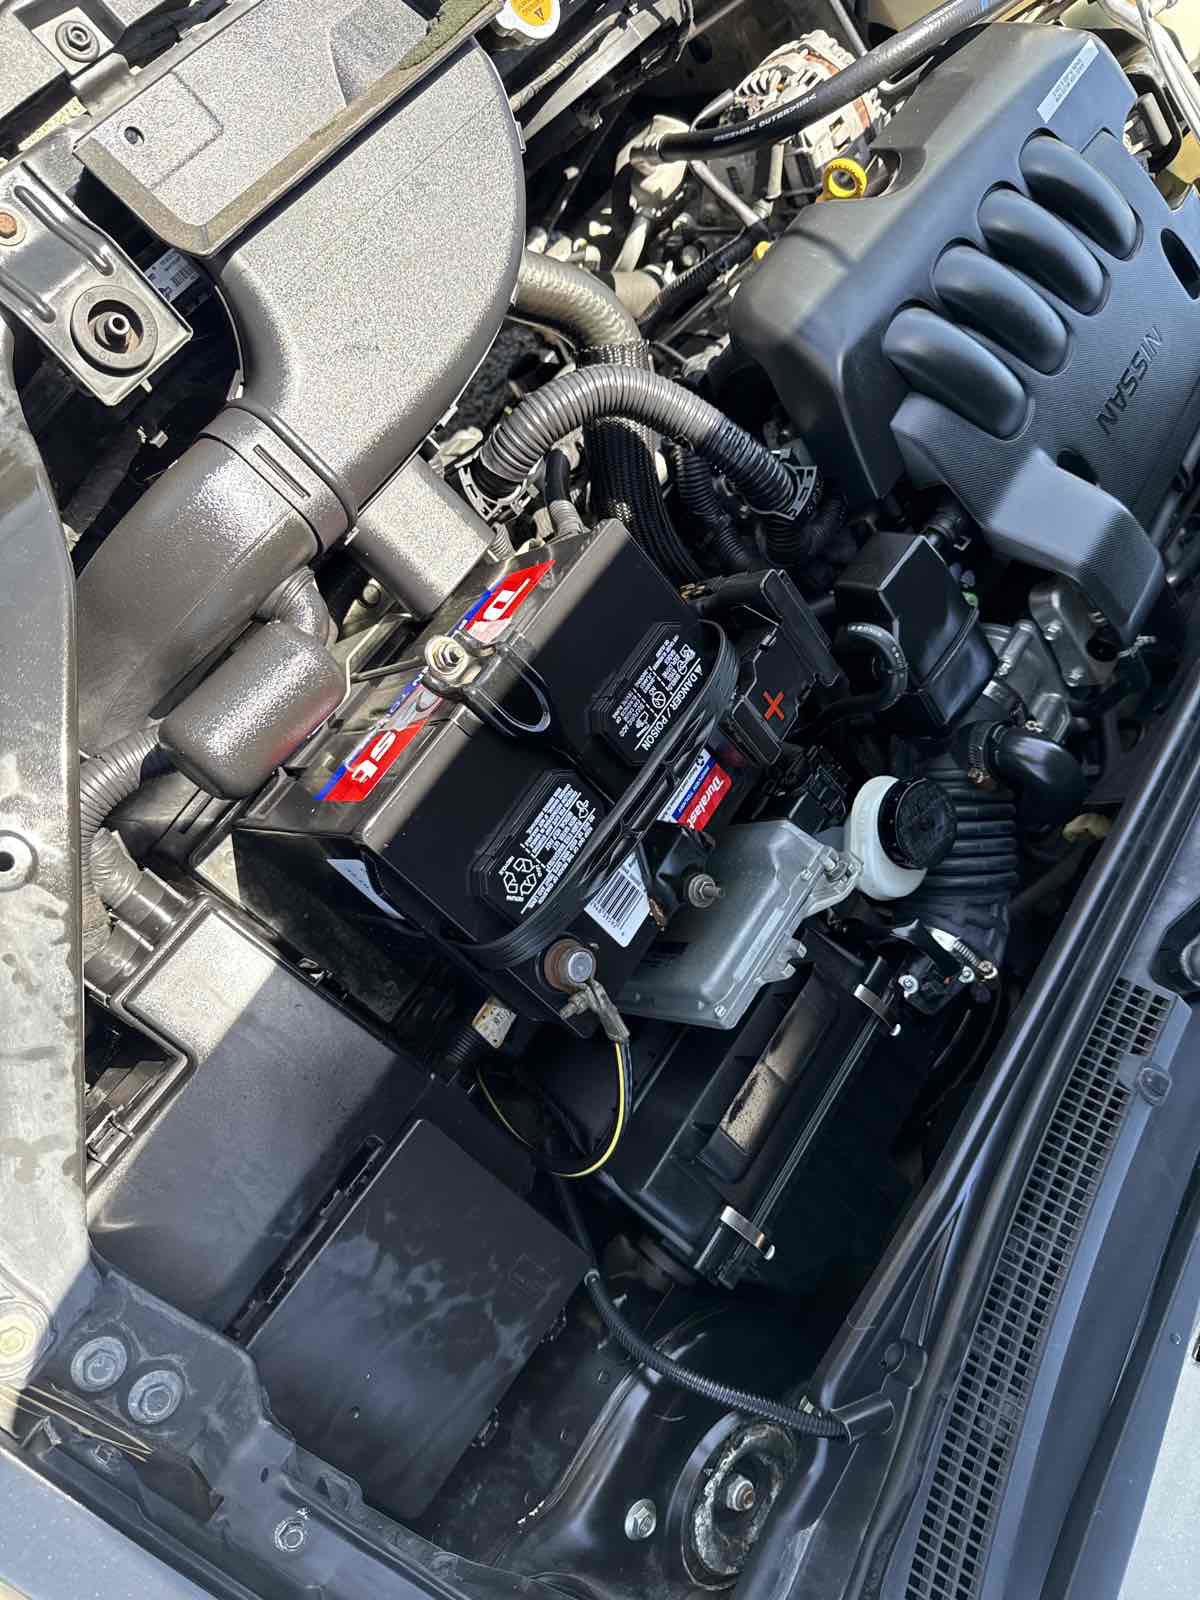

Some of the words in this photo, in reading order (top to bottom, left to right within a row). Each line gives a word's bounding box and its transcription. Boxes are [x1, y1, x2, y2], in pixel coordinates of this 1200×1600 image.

[1095, 326, 1164, 438] NISSAN
[647, 685, 656, 696] NO
[668, 671, 697, 710] DANGER
[641, 714, 667, 750] POISON
[685, 775, 724, 829] Duralast
